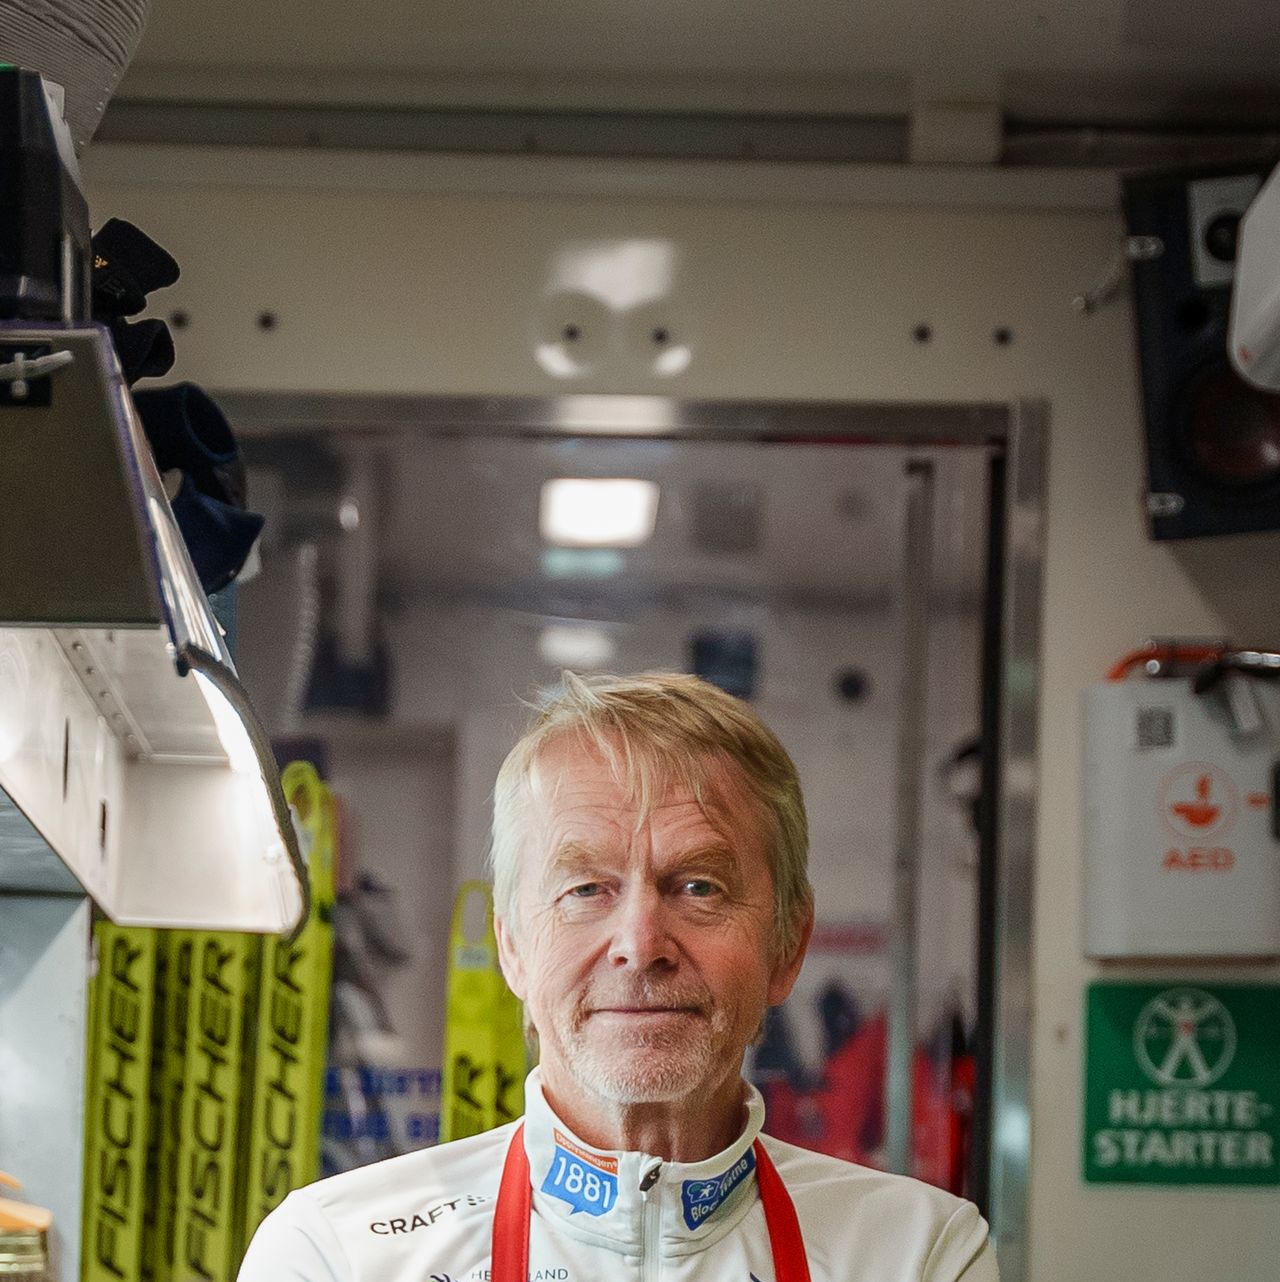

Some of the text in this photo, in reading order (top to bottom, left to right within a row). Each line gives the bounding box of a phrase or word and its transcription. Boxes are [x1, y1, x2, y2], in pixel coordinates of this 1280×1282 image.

[1162, 848, 1235, 872] AED
[96, 936, 144, 1281] FISCHER
[185, 939, 235, 1281] FISCHER
[1108, 1089, 1273, 1128] HJERTE-
[1094, 1129, 1275, 1168] STARTER
[552, 1156, 611, 1209] 1881
[370, 1198, 461, 1236] CRAFT
